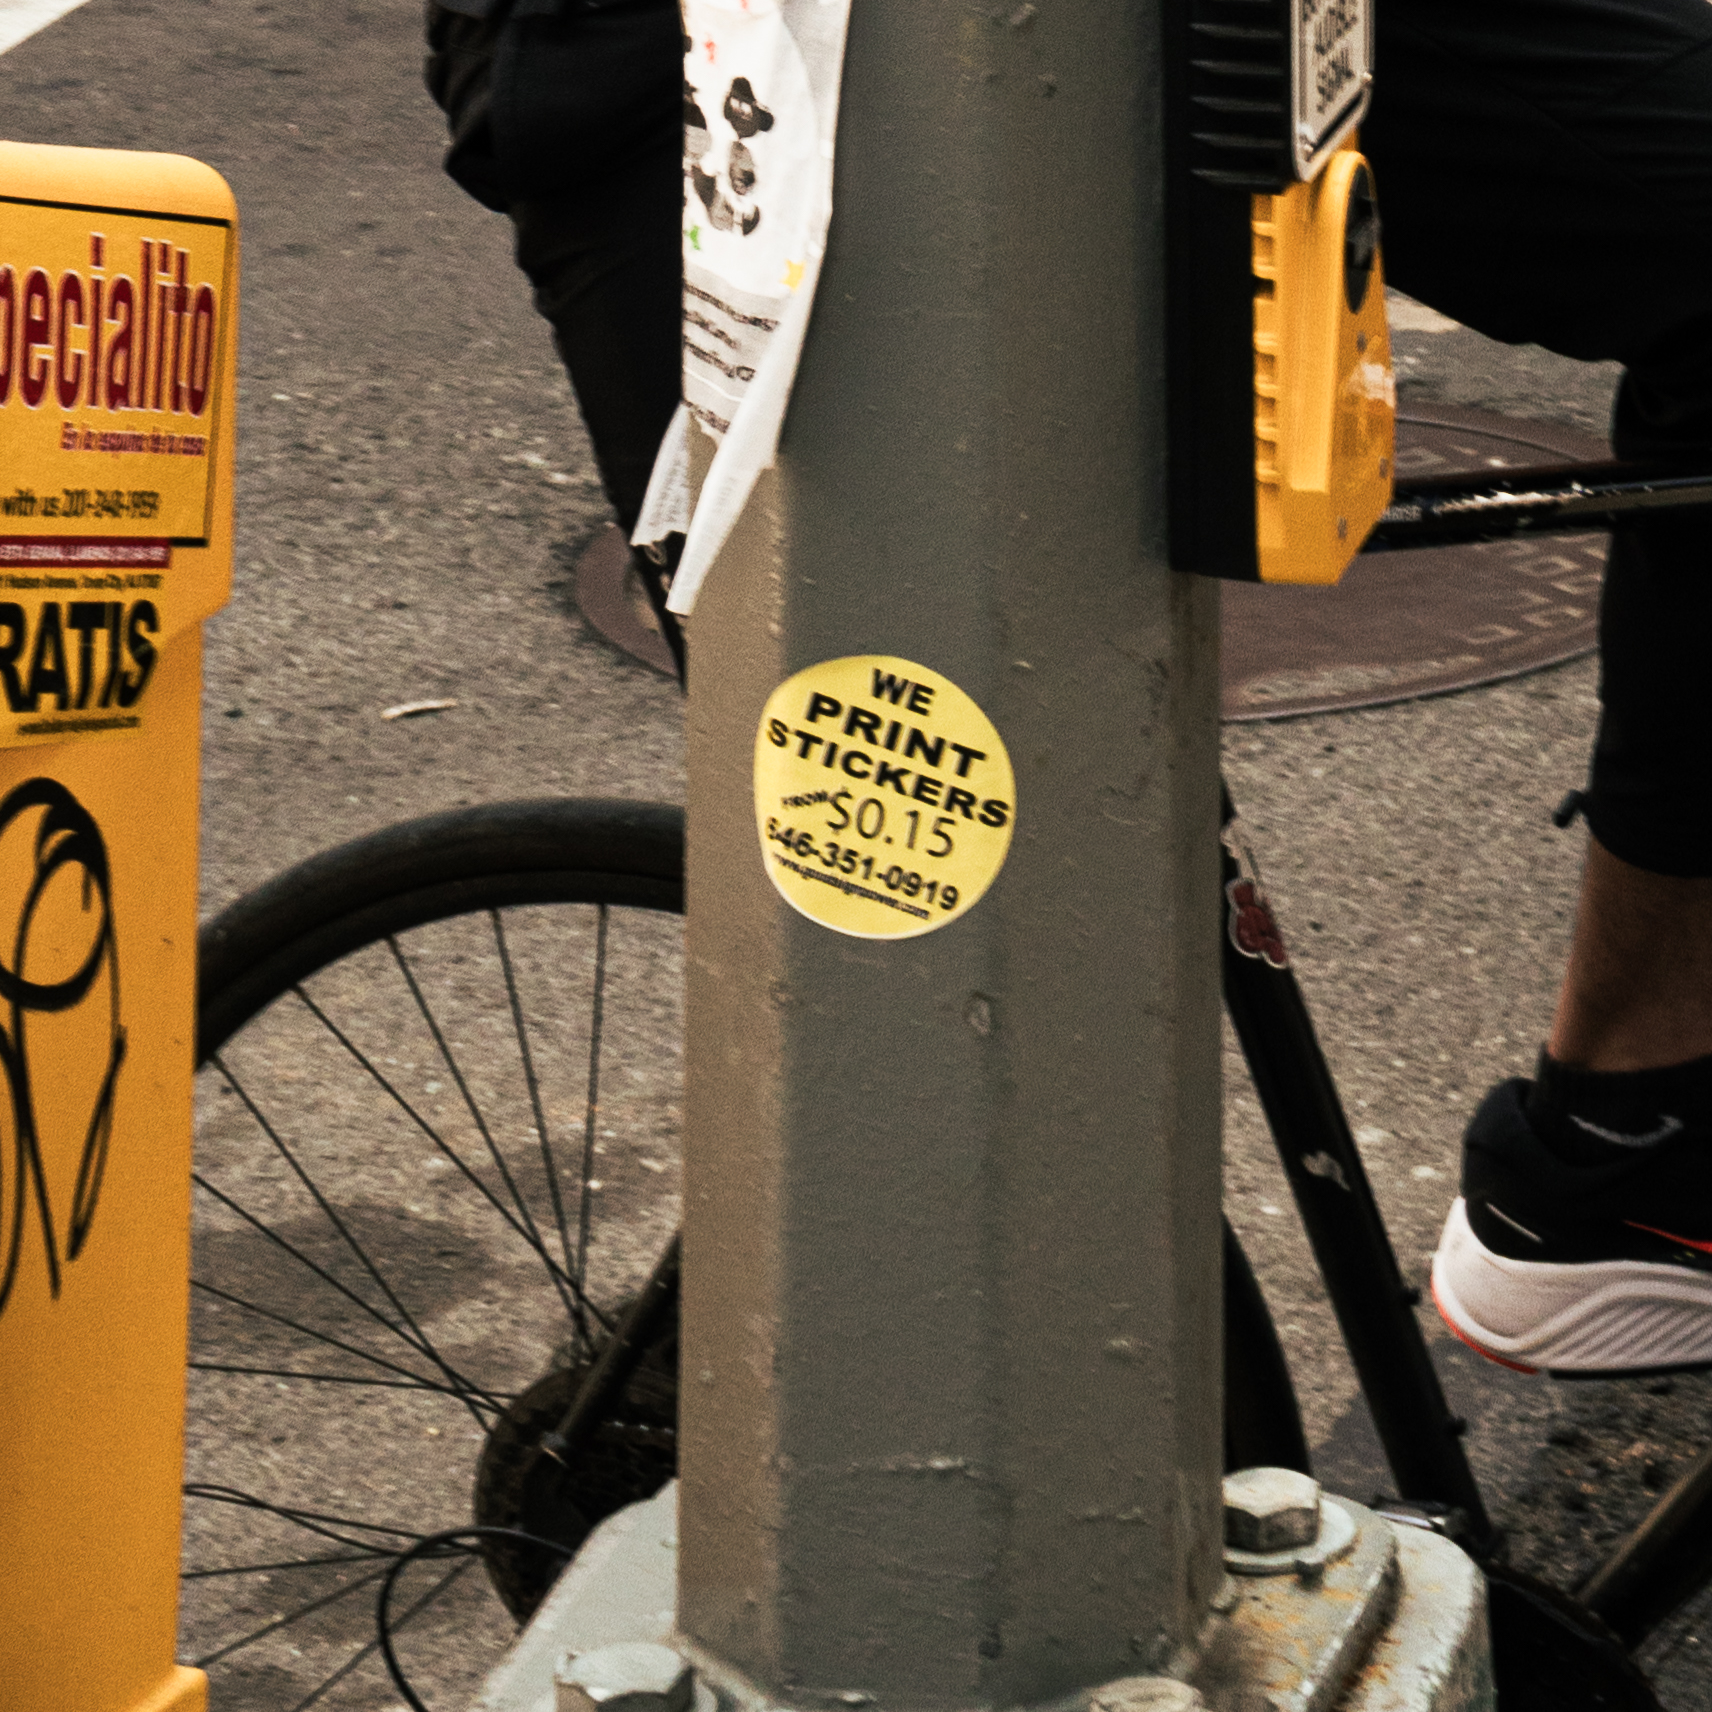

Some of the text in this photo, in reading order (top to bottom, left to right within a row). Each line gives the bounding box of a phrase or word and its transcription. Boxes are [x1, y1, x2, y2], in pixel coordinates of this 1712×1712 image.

[872, 667, 936, 717] WE
[767, 717, 1010, 829] STICKERS
[804, 690, 987, 779] PRINT
[826, 785, 957, 859] $0.15
